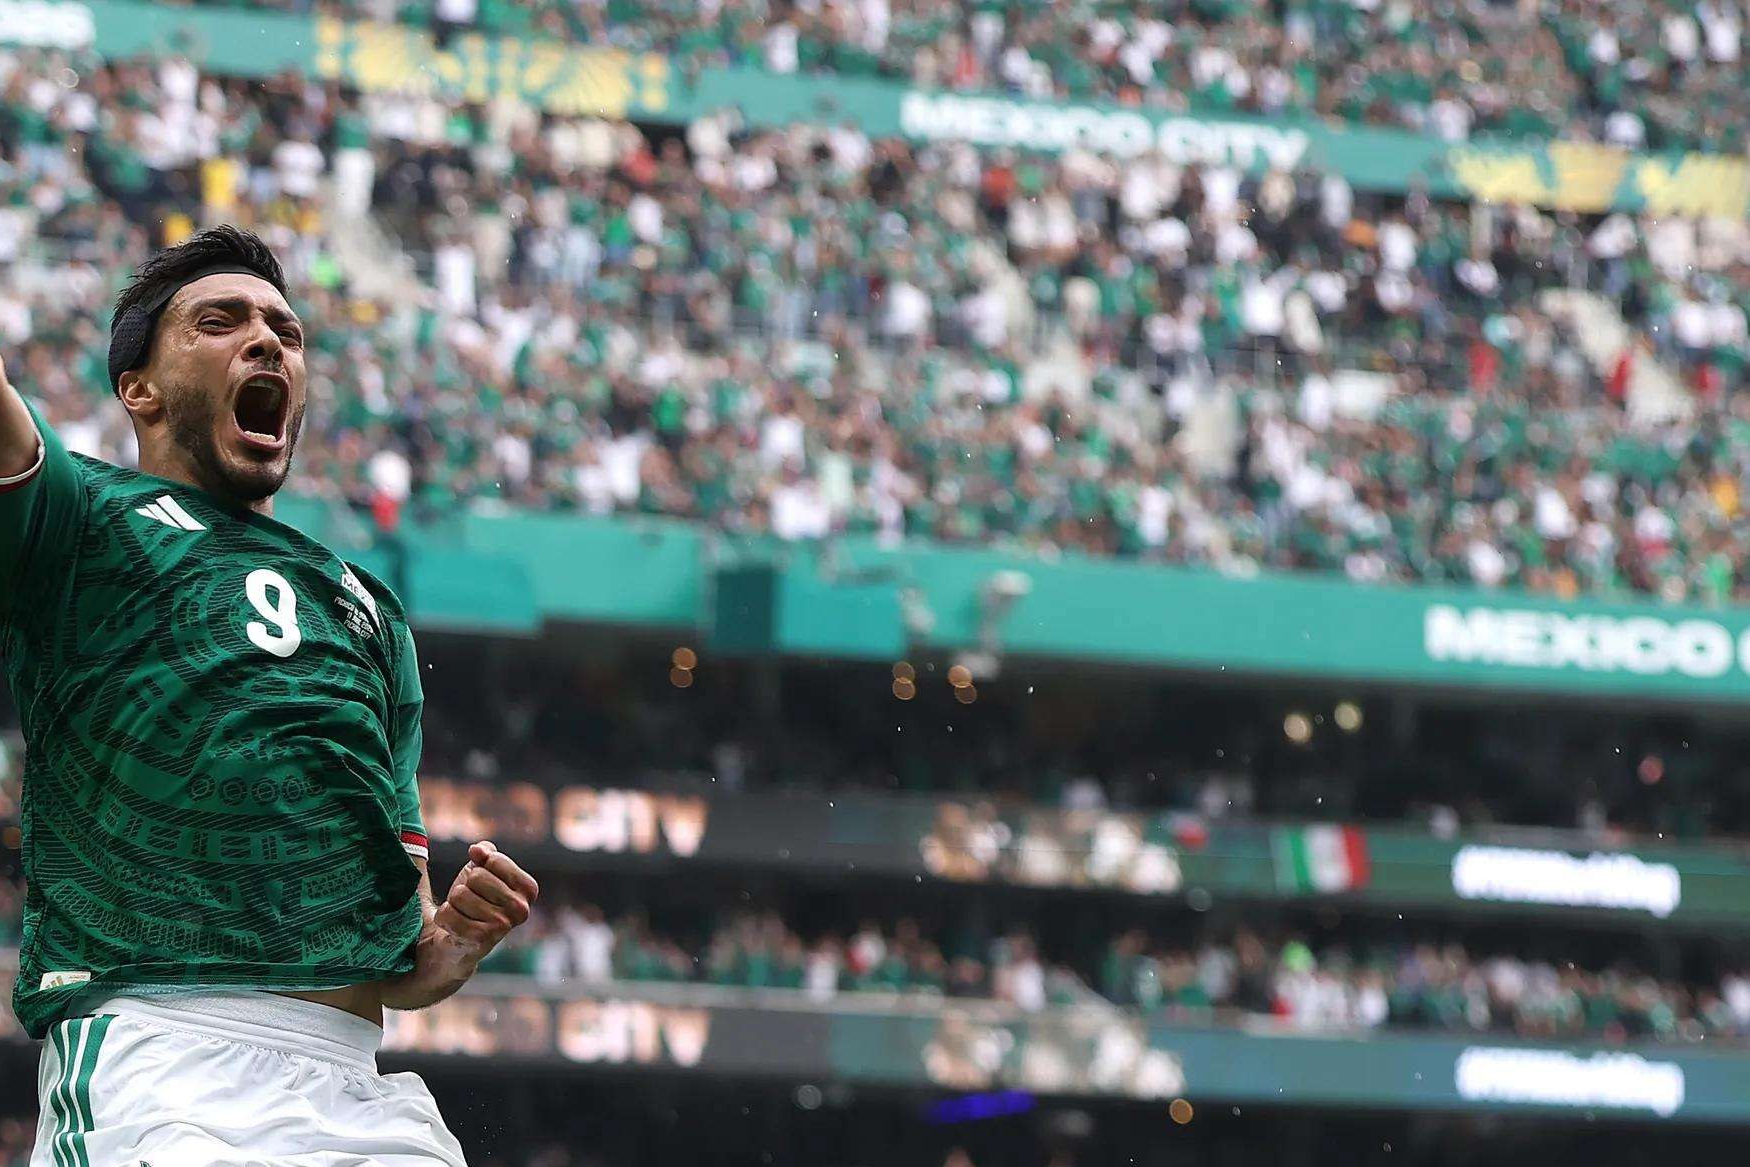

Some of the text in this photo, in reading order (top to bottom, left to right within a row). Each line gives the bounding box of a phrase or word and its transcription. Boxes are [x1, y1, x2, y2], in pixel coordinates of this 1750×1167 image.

[899, 91, 1308, 171] MEXICO CITY
[245, 568, 302, 658] 9
[1424, 604, 1734, 678] MEXICO
